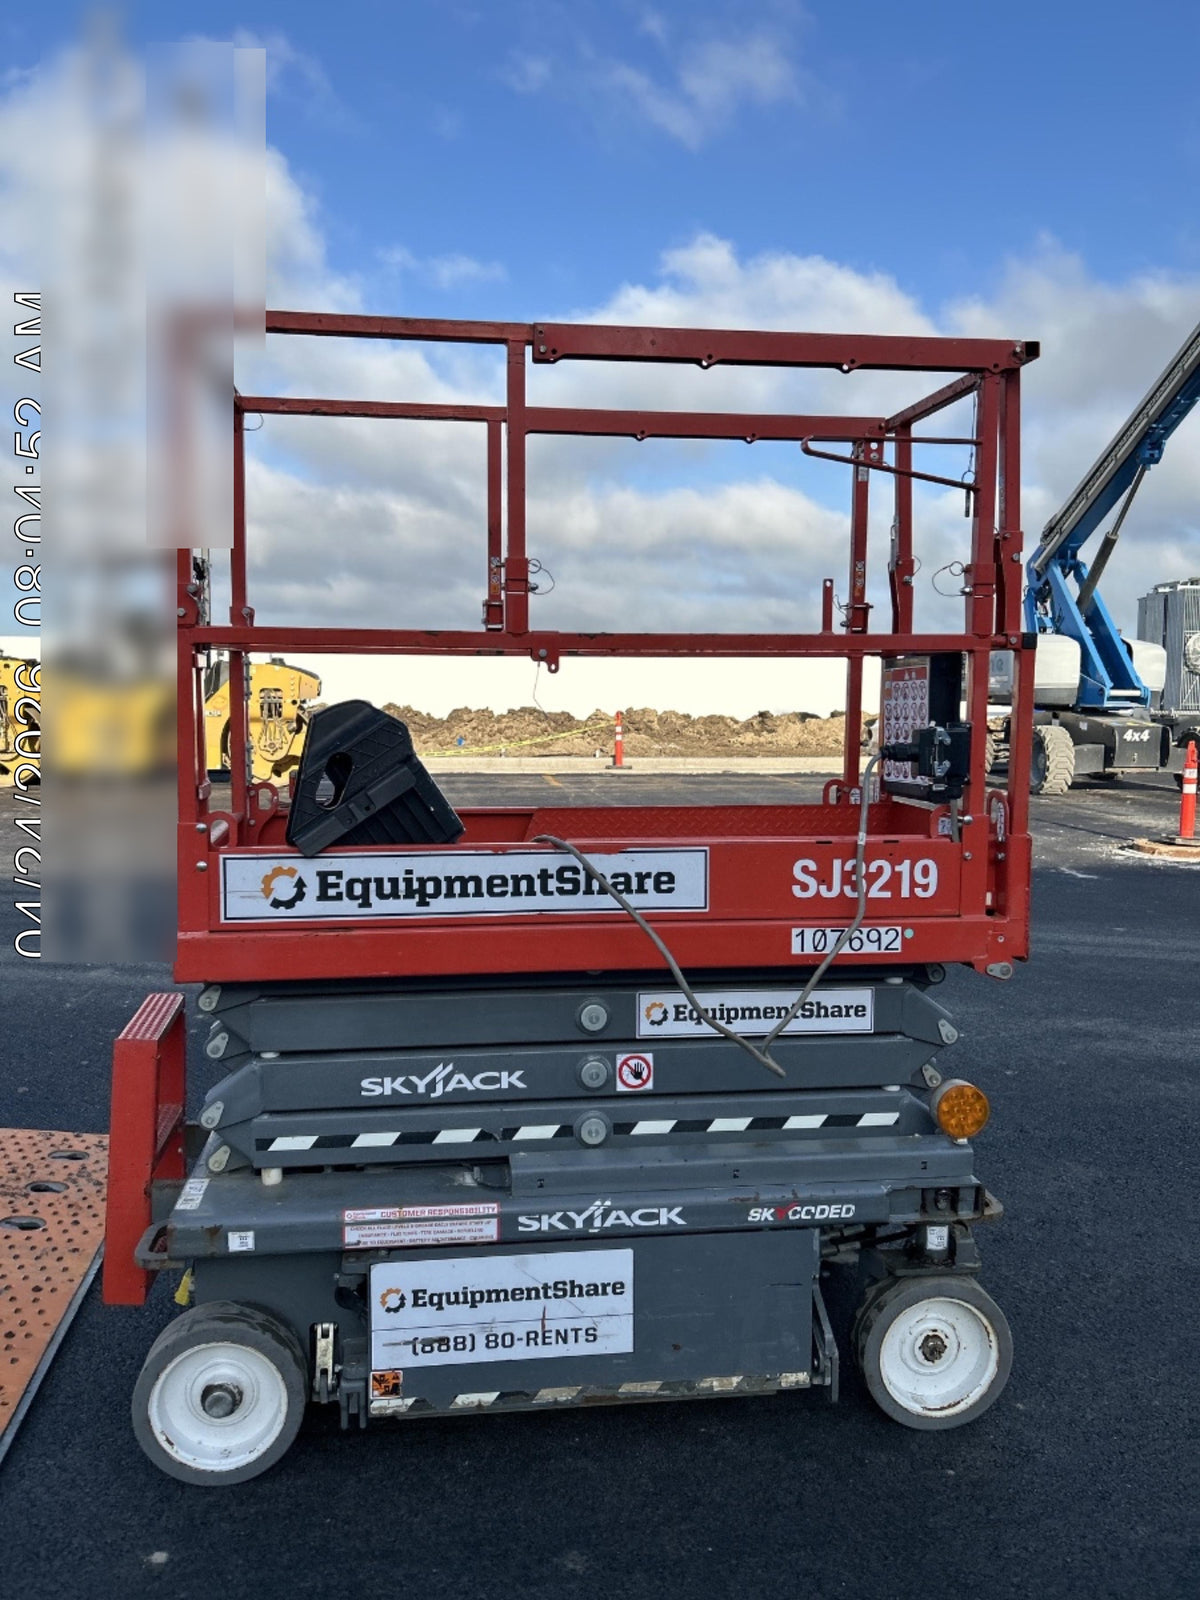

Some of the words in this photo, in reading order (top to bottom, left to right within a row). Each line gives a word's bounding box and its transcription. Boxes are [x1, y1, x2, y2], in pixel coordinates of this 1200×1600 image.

[1122, 729, 1150, 742] 4x4
[316, 865, 675, 908] EquipmentShare
[791, 858, 938, 898] SJ3219
[795, 927, 900, 952] 107692
[360, 1062, 528, 1098] SKYJACK
[517, 1199, 688, 1232] SKYJACK
[411, 1280, 625, 1311] EquipmentShare
[484, 1326, 598, 1350] 80-RENTS
